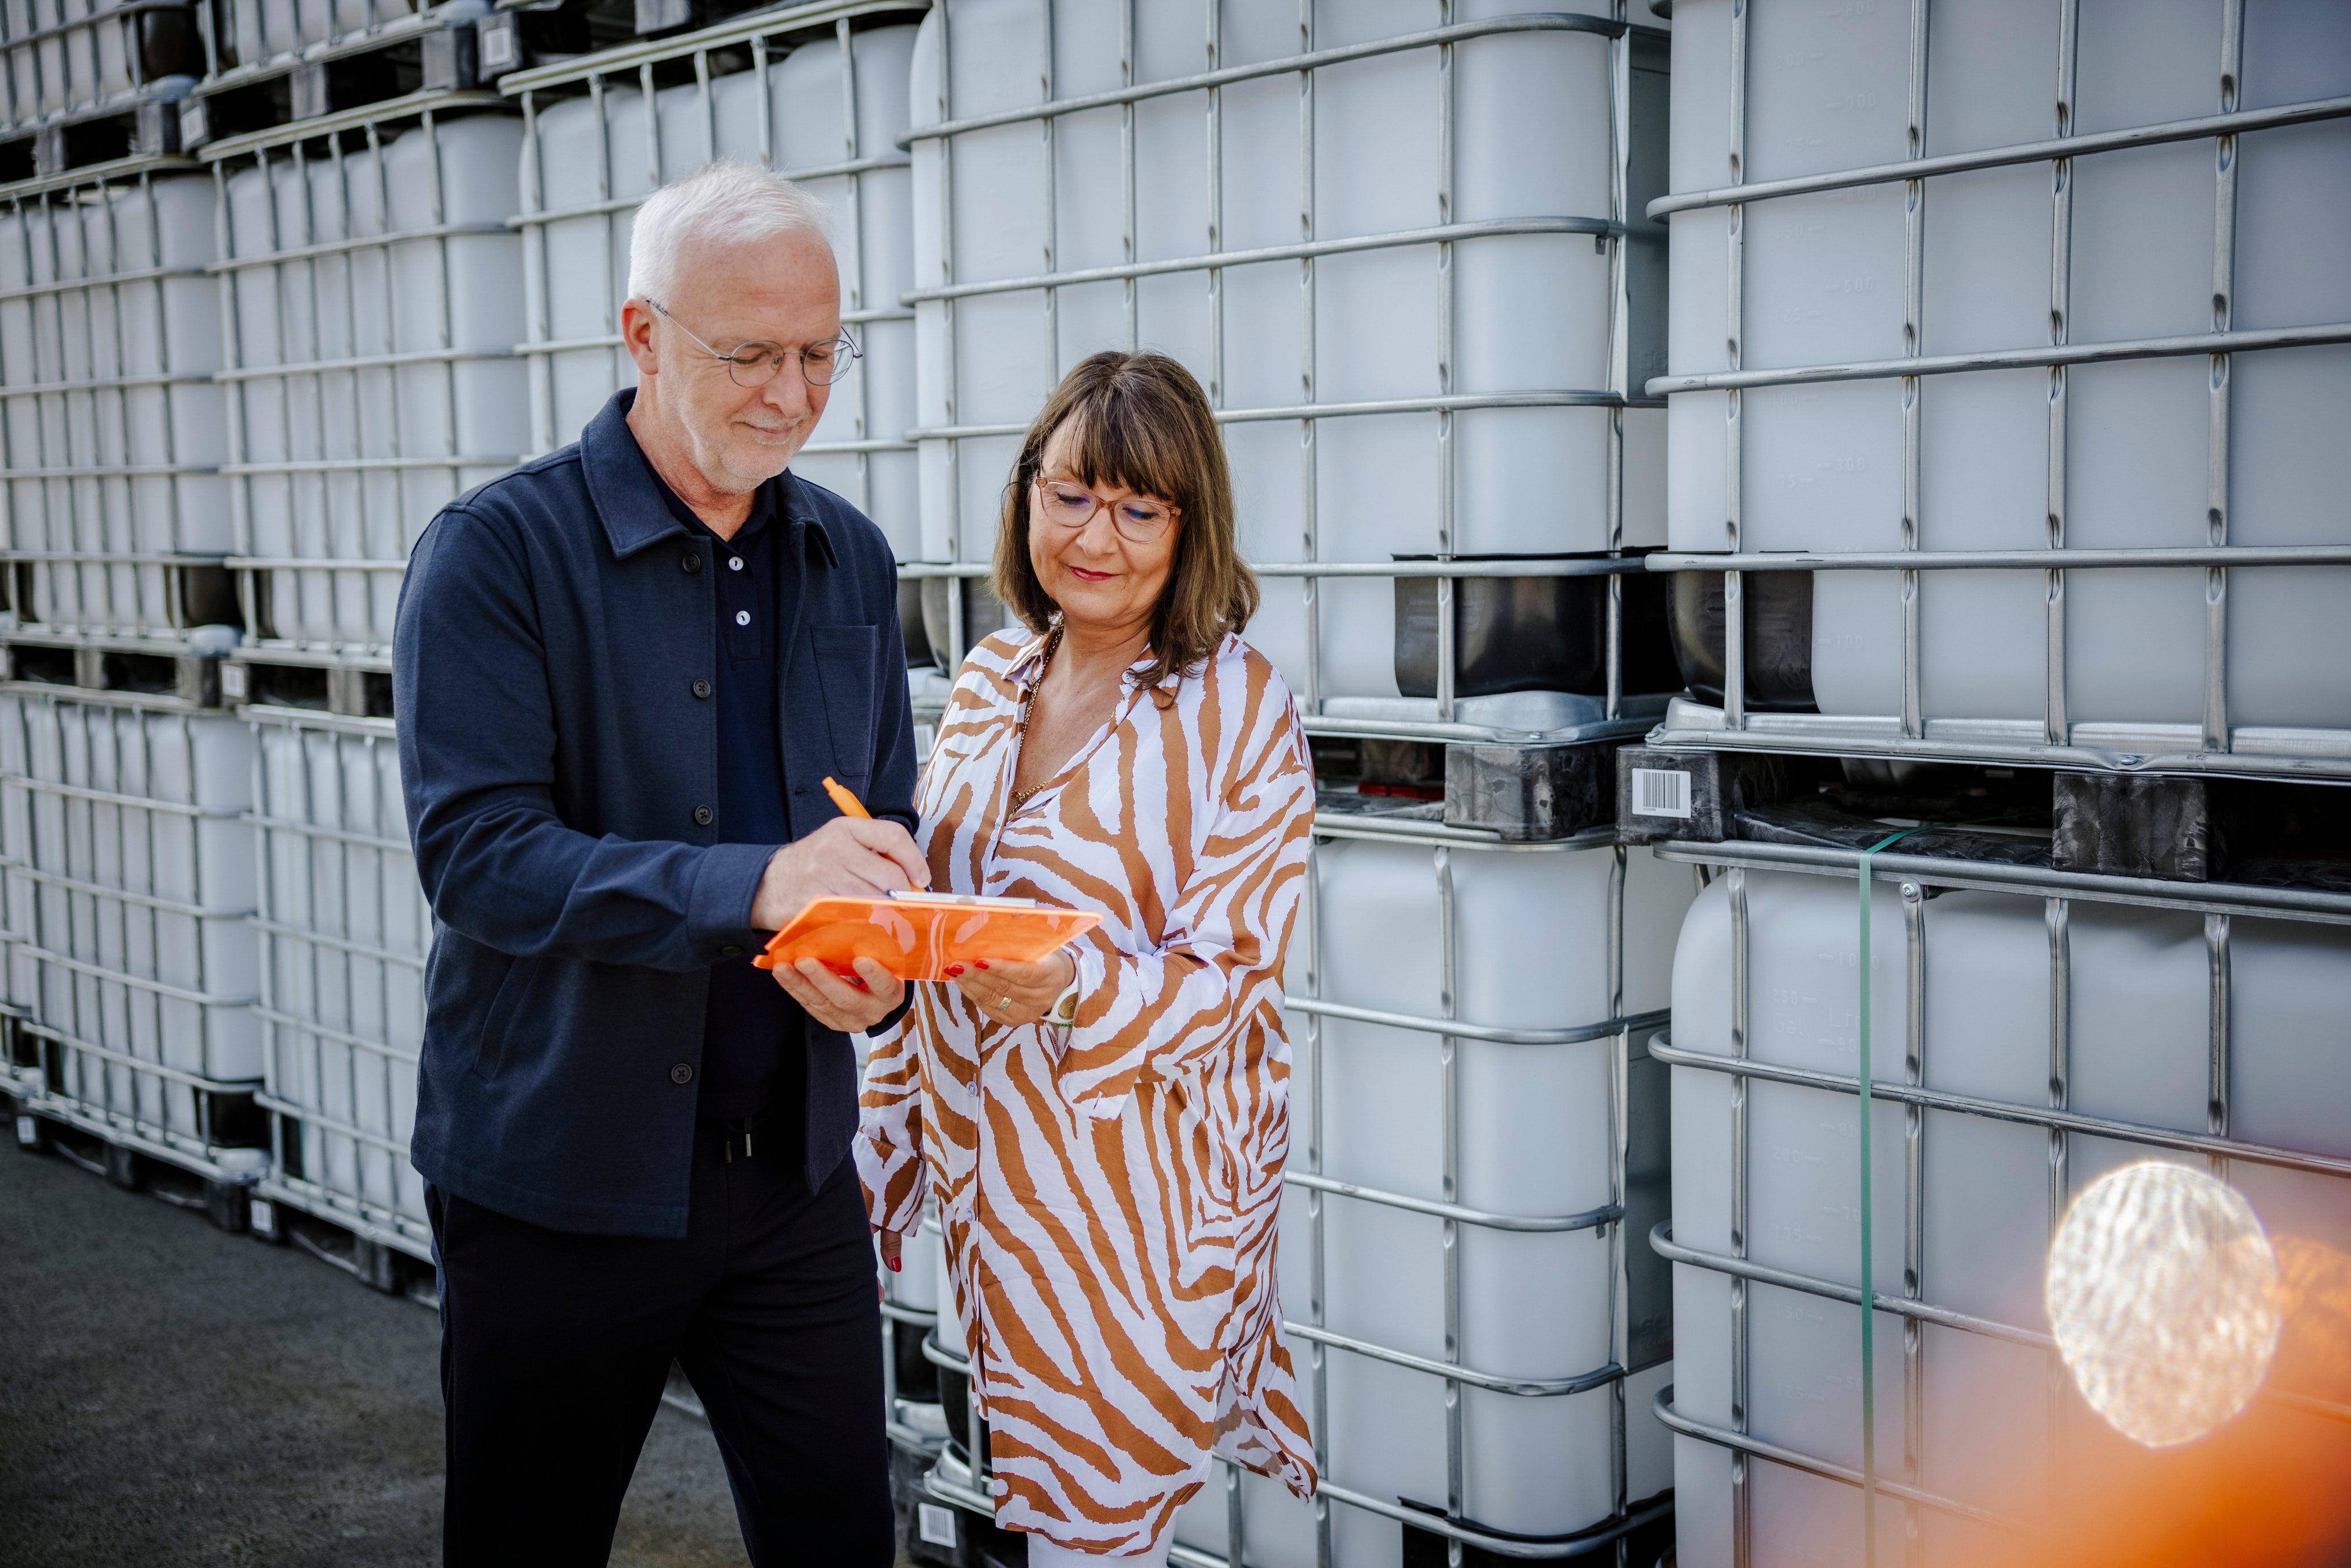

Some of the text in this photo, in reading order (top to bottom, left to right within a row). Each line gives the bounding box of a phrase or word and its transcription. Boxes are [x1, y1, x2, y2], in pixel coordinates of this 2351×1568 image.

[1845, 0, 1876, 18] 800
[1776, 52, 1803, 71] 200
[1847, 92, 1877, 110] 700
[1775, 225, 1803, 239] 150
[1845, 276, 1874, 293] 500
[1774, 307, 1801, 323] 125
[1836, 456, 1866, 472] 300
[1779, 474, 1796, 489] 75
[1835, 634, 1863, 649] 100
[1839, 951, 1880, 970] 100
[1772, 988, 1798, 1005] 250
[1773, 1012, 1811, 1037] Gal.
[1837, 1036, 1859, 1053] 90
[1839, 1122, 1858, 1138] 80
[1773, 1145, 1800, 1164] 200
[1842, 1205, 1861, 1222] 70
[1775, 1224, 1802, 1242] 175
[1775, 1304, 1803, 1321] 150
[1776, 1382, 1804, 1401] 125
[1845, 1374, 1862, 1392] 50
